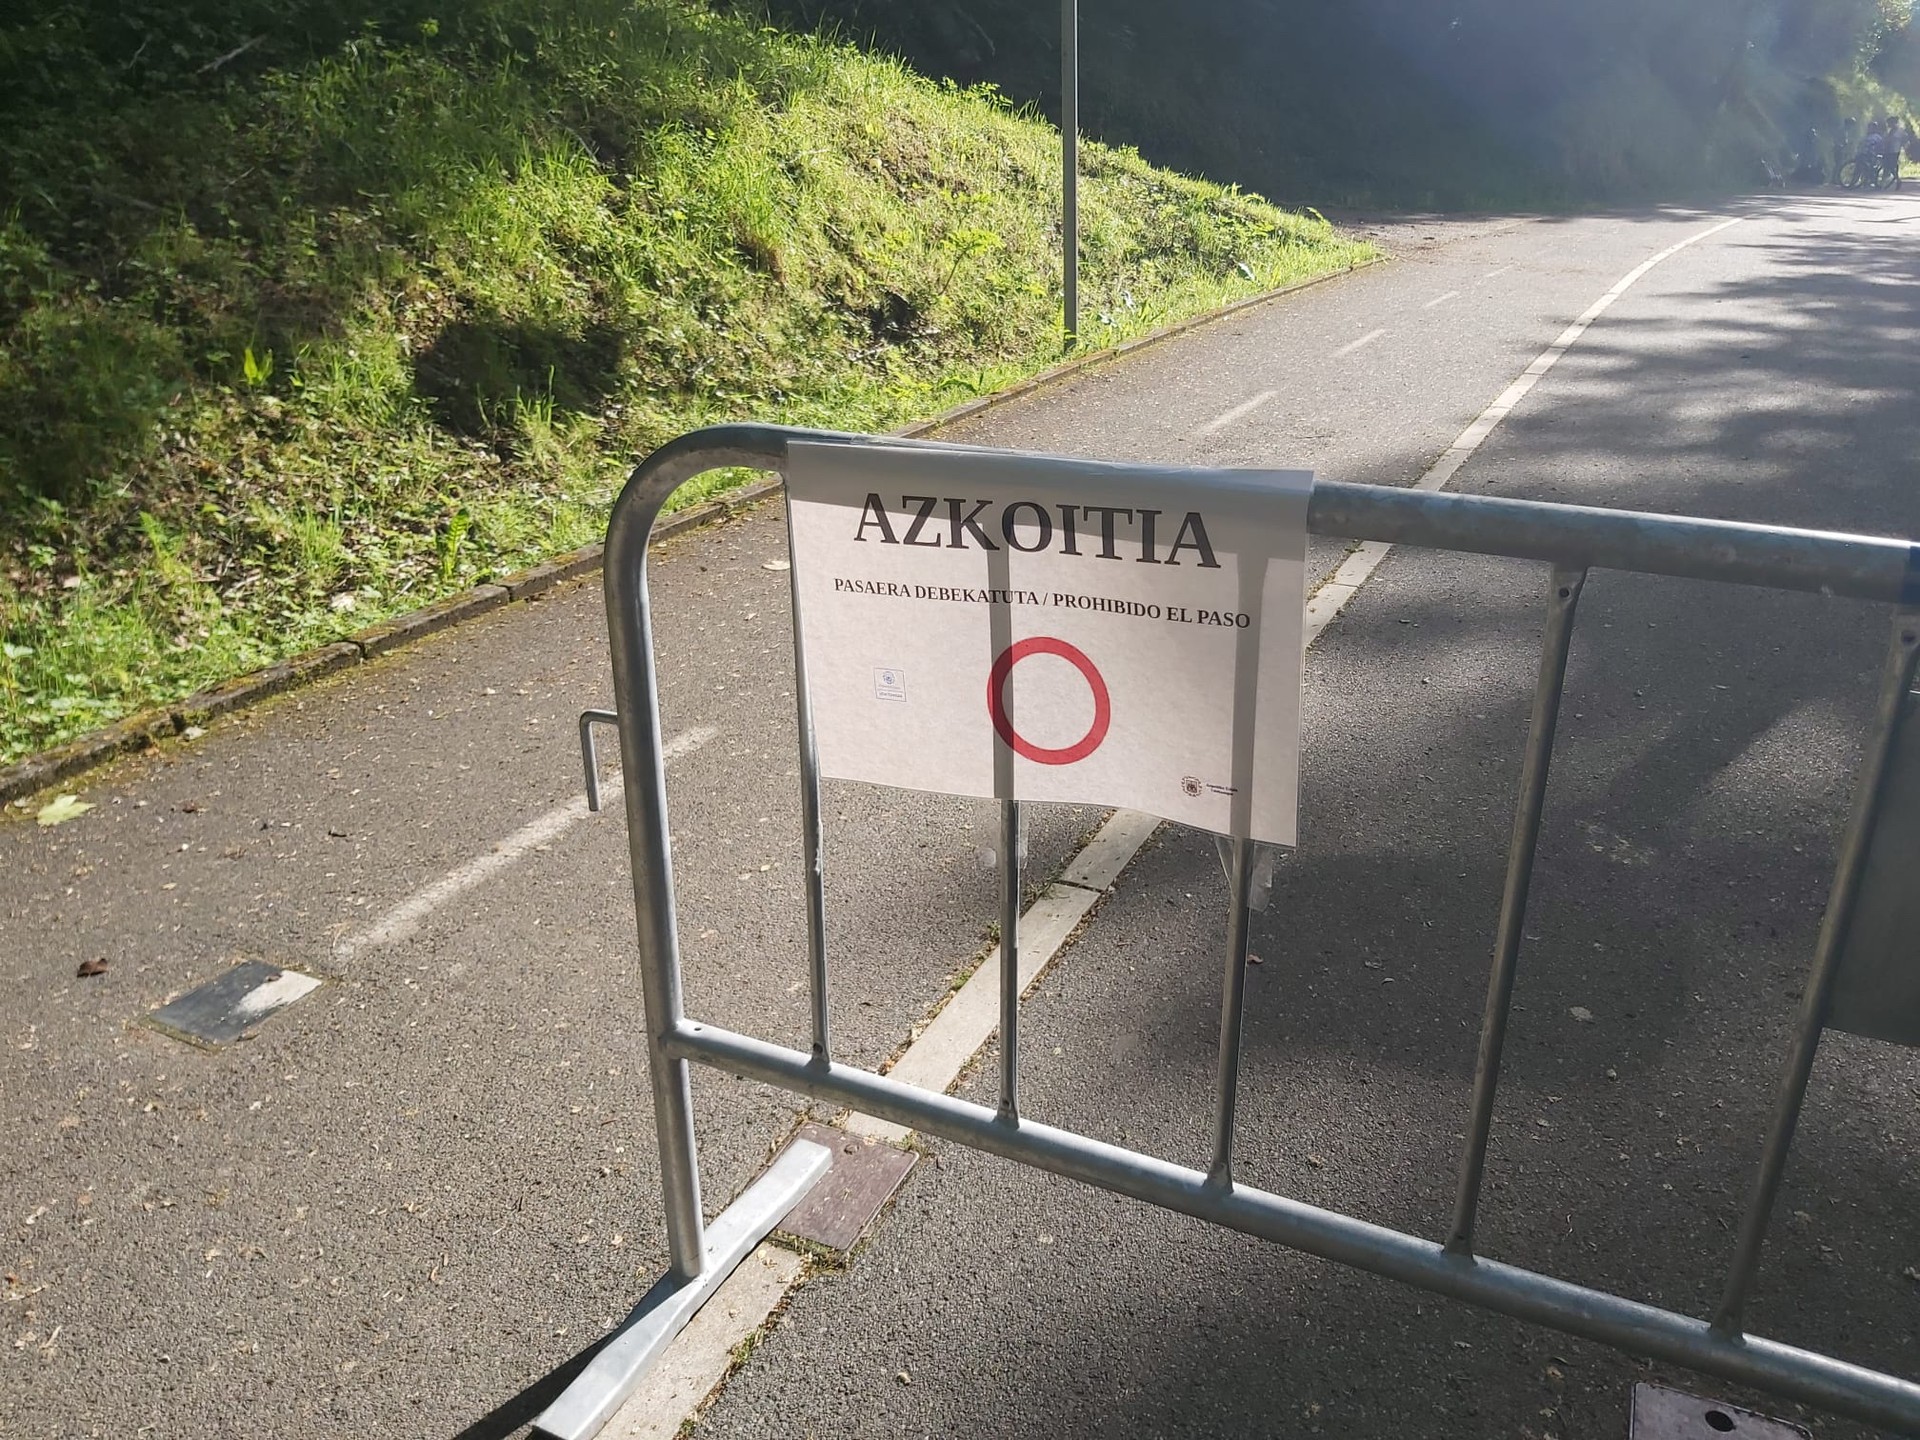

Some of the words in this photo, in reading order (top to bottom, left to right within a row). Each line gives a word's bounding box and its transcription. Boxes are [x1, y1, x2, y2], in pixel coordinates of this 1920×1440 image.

[853, 492, 1221, 568] AZKOITIA
[834, 578, 911, 597] PASAERA
[914, 585, 1039, 605] DEBEKATUTA
[1042, 592, 1049, 606] /
[1053, 593, 1160, 618] PROHIBIDO
[1166, 606, 1192, 623] EL
[1196, 609, 1250, 628] PASO
